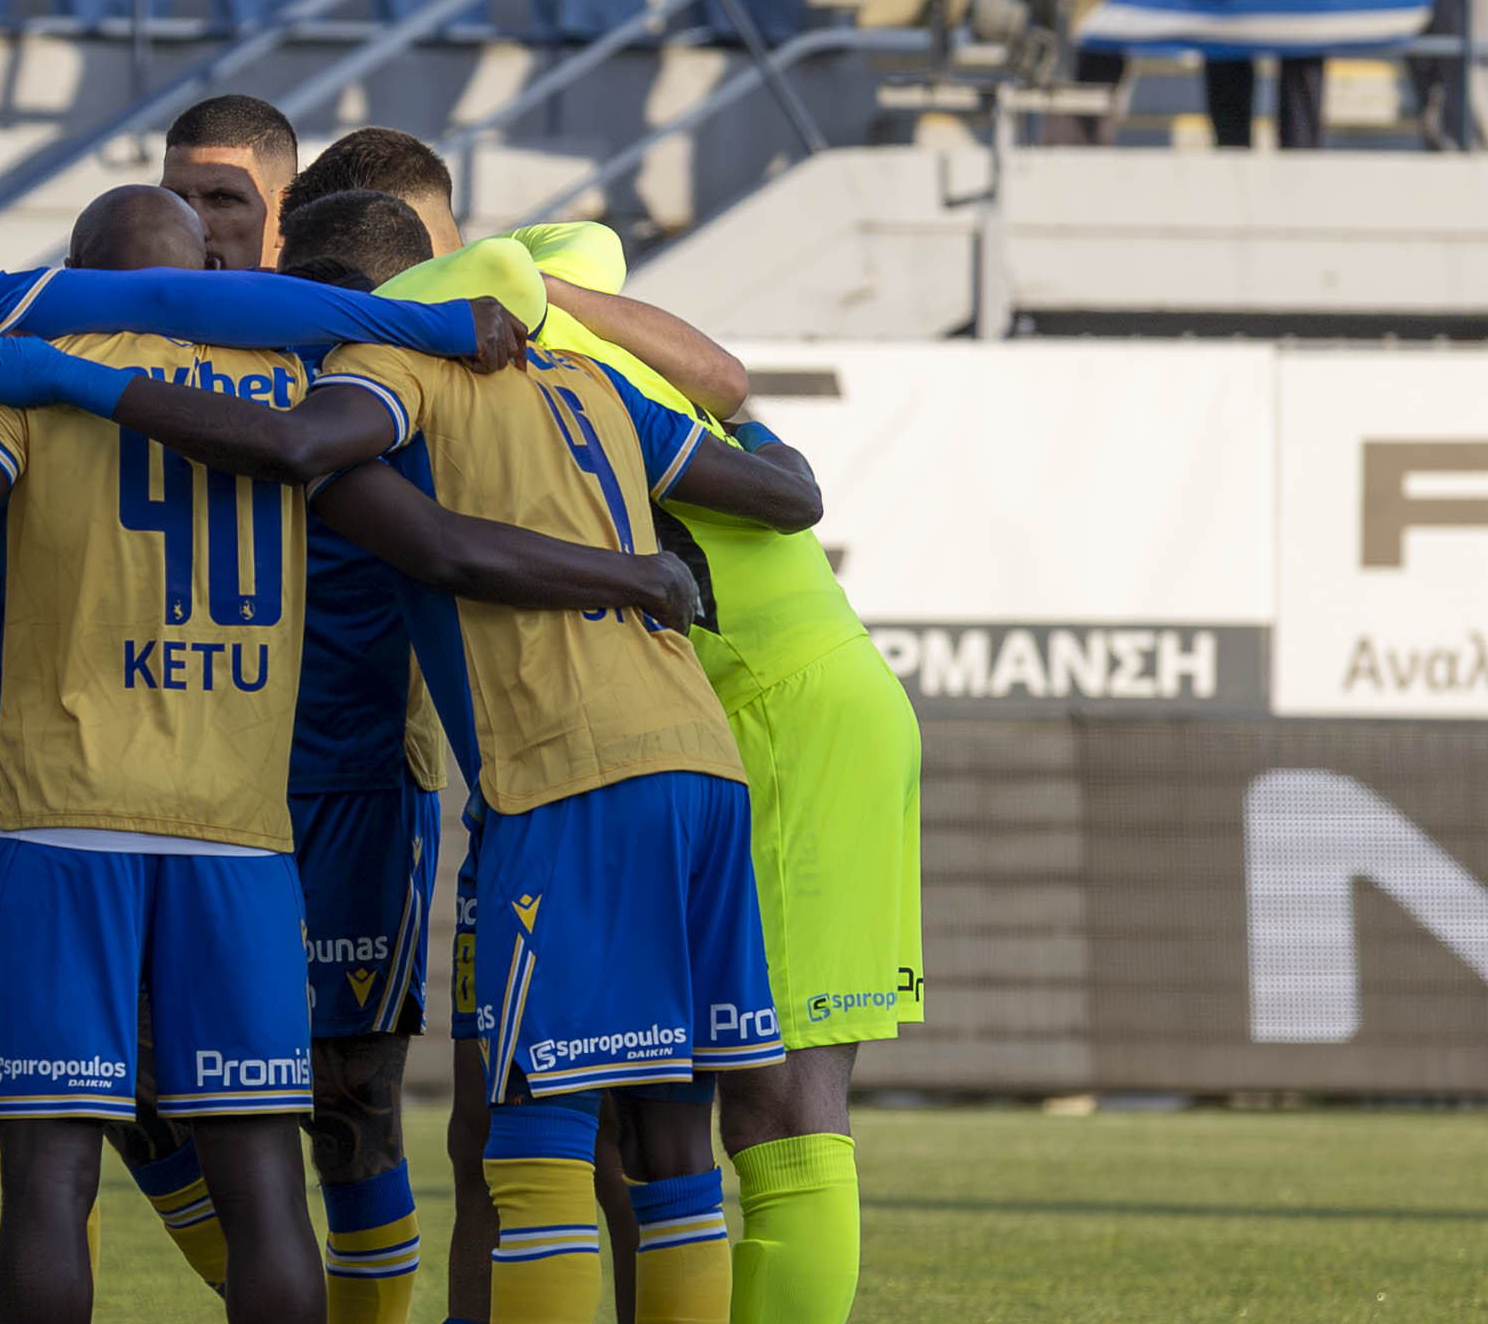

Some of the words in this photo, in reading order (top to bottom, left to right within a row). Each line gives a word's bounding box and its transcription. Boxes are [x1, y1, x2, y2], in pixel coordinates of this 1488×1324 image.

[124, 639, 268, 693] KETU
[710, 1003, 780, 1041] Pro
[196, 1047, 311, 1087] Promis
[626, 1048, 674, 1061] DAIKIN
[67, 1078, 112, 1089] DAIKIN
